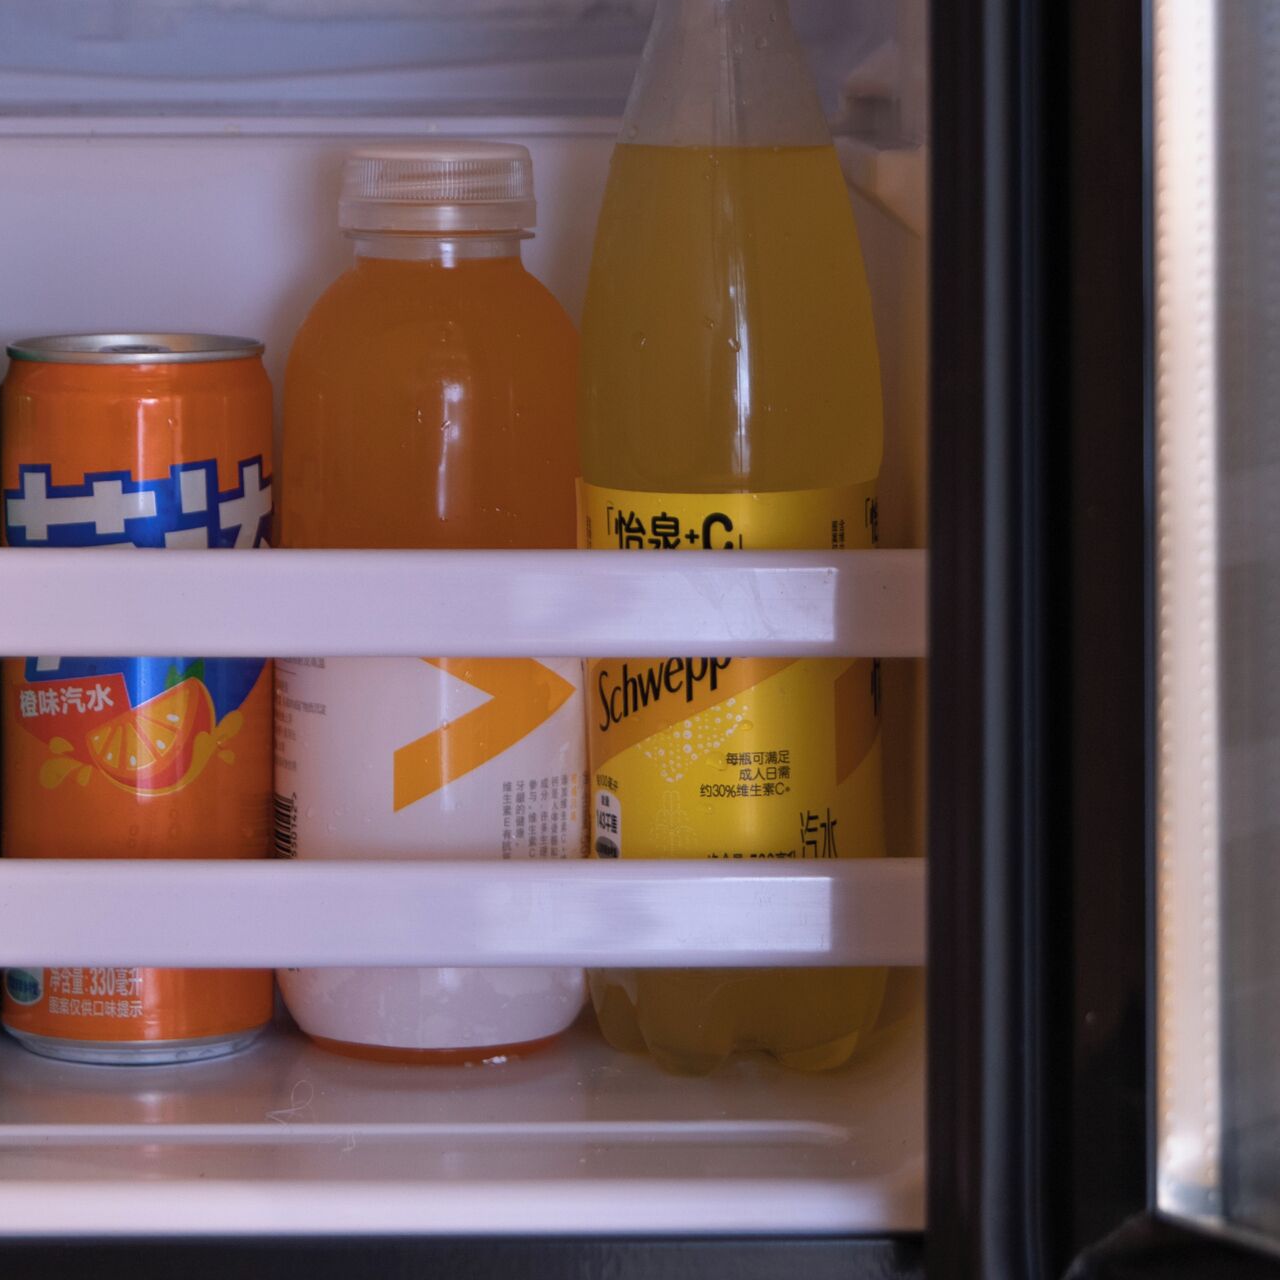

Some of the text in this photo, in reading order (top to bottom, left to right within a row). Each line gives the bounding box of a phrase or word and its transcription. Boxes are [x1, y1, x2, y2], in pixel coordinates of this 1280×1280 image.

[20, 684, 115, 718] 橙味汽水
[726, 750, 790, 766] 每瓶可满足
[739, 766, 791, 781] 成人日需
